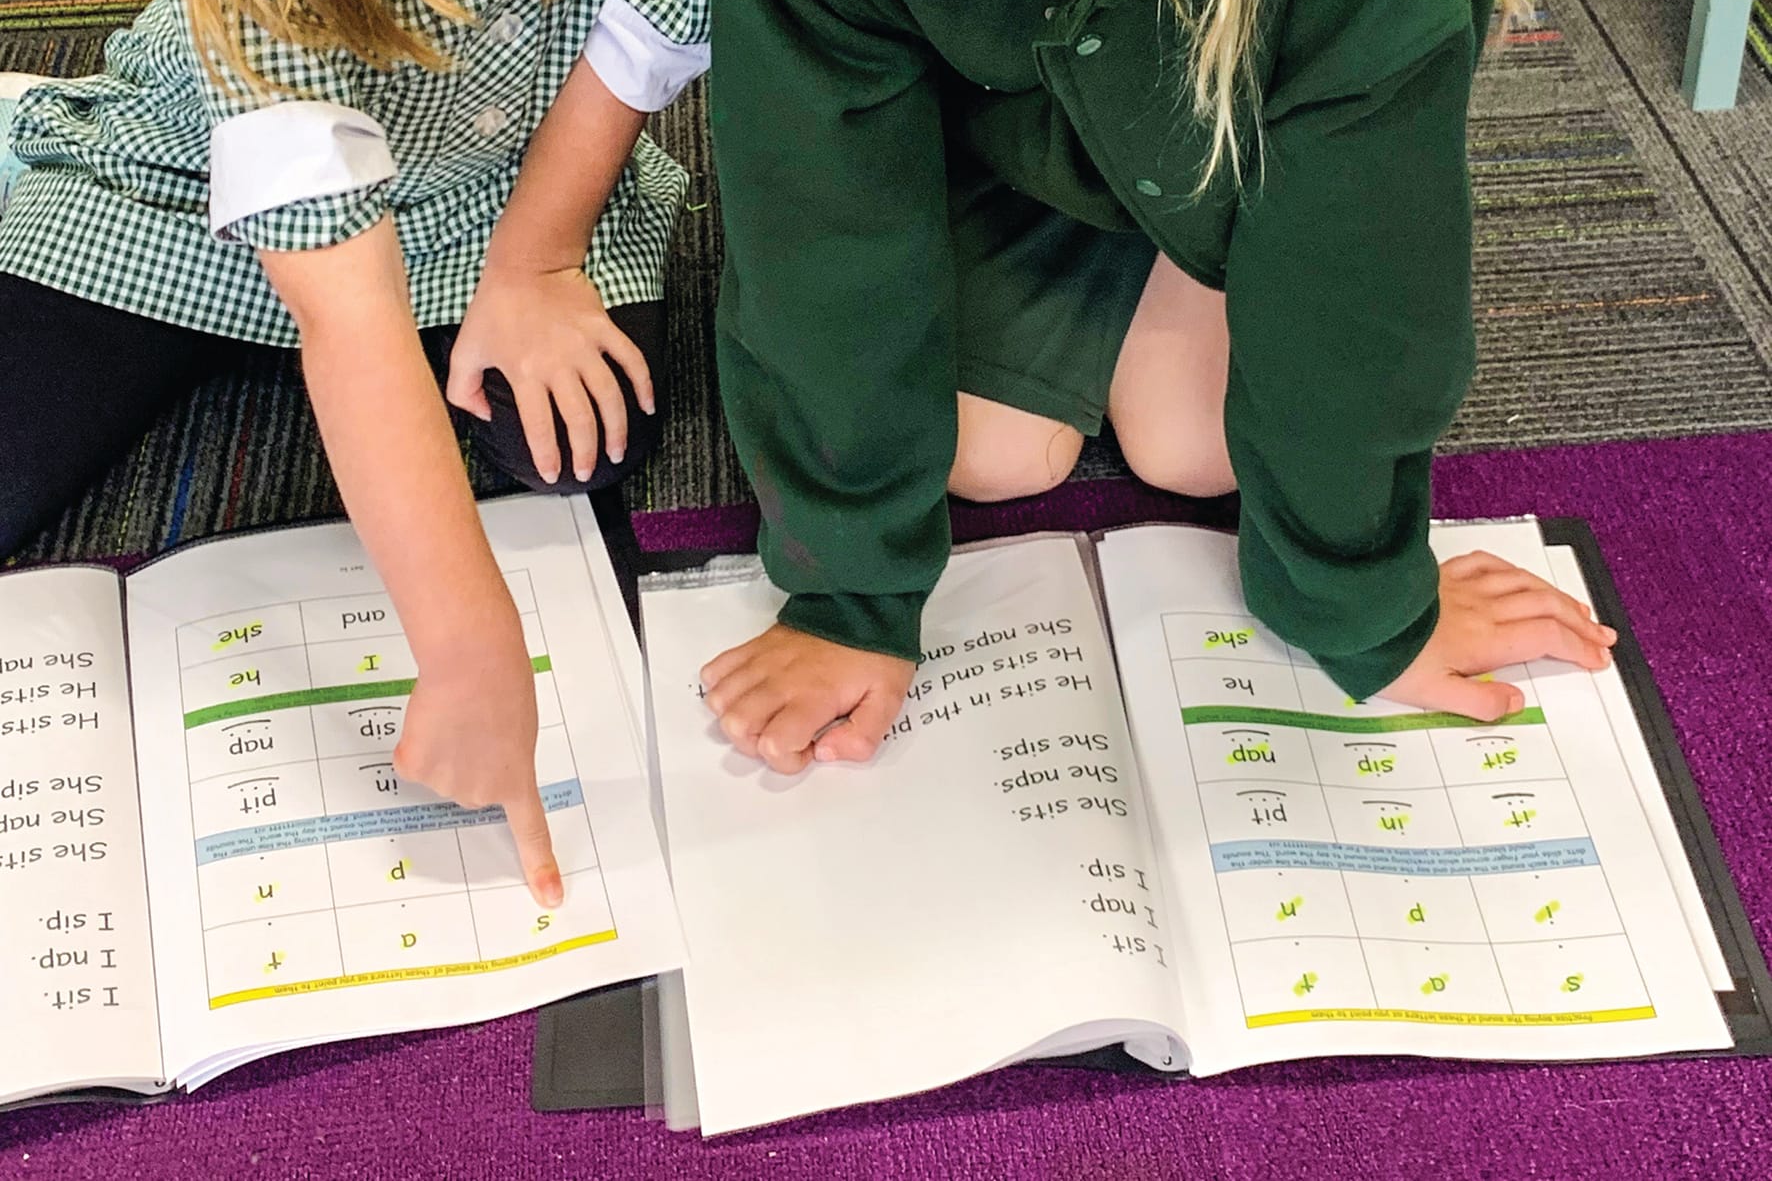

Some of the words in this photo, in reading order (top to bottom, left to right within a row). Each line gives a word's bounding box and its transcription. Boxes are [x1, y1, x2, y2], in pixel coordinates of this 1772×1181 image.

[342, 610, 386, 629] and
[1024, 618, 1072, 635] She
[218, 624, 263, 644] she
[963, 628, 1016, 653] naps
[1204, 630, 1248, 649] she
[43, 652, 94, 670] She
[364, 655, 379, 672] I
[992, 650, 1038, 673] sits
[1046, 646, 1083, 662] He
[0, 657, 33, 674] na
[229, 670, 261, 686] he
[941, 664, 984, 690] and
[1054, 674, 1092, 692] He
[1222, 677, 1255, 697] he
[0, 685, 50, 705] sits
[59, 682, 96, 699] He
[906, 679, 932, 700] sh
[999, 678, 1046, 700] sits
[969, 692, 992, 707] in
[61, 712, 98, 730] He
[919, 700, 962, 726] the
[2, 715, 52, 736] sits
[359, 720, 396, 740] sip
[228, 736, 274, 756] nap
[993, 738, 1050, 761] sips.
[1058, 734, 1108, 751] She
[1231, 743, 1276, 765] nap
[1483, 751, 1516, 770] sit
[1068, 764, 1118, 783] She
[1357, 754, 1394, 778] sip
[49, 775, 103, 795] She
[375, 779, 399, 796] in
[994, 768, 1060, 794] naps.
[239, 788, 276, 814] pit
[1011, 799, 1068, 822] sits.
[1077, 797, 1128, 817] She
[50, 808, 105, 828] She
[1250, 803, 1288, 827] pit
[1510, 810, 1531, 829] it
[1380, 816, 1405, 836] in
[52, 842, 108, 862] She
[390, 860, 405, 882] p
[1080, 858, 1126, 882] sip.
[1134, 868, 1149, 892] I
[258, 884, 273, 900] n
[1082, 892, 1136, 916] nap.
[1280, 902, 1296, 917] n
[1409, 902, 1425, 923] p
[39, 910, 87, 934] sip.
[98, 912, 114, 931] I
[537, 915, 550, 931] s
[1144, 906, 1159, 930] I
[1545, 906, 1554, 926] i
[400, 933, 417, 948] a
[1102, 934, 1146, 955] sit.
[31, 948, 88, 970] nap.
[100, 949, 117, 968] I
[268, 952, 282, 970] t
[1153, 944, 1168, 969] I
[1300, 974, 1314, 994] t
[1428, 976, 1446, 992] a
[1566, 976, 1581, 992] s
[44, 988, 91, 1010] sit.
[102, 986, 120, 1006] I
